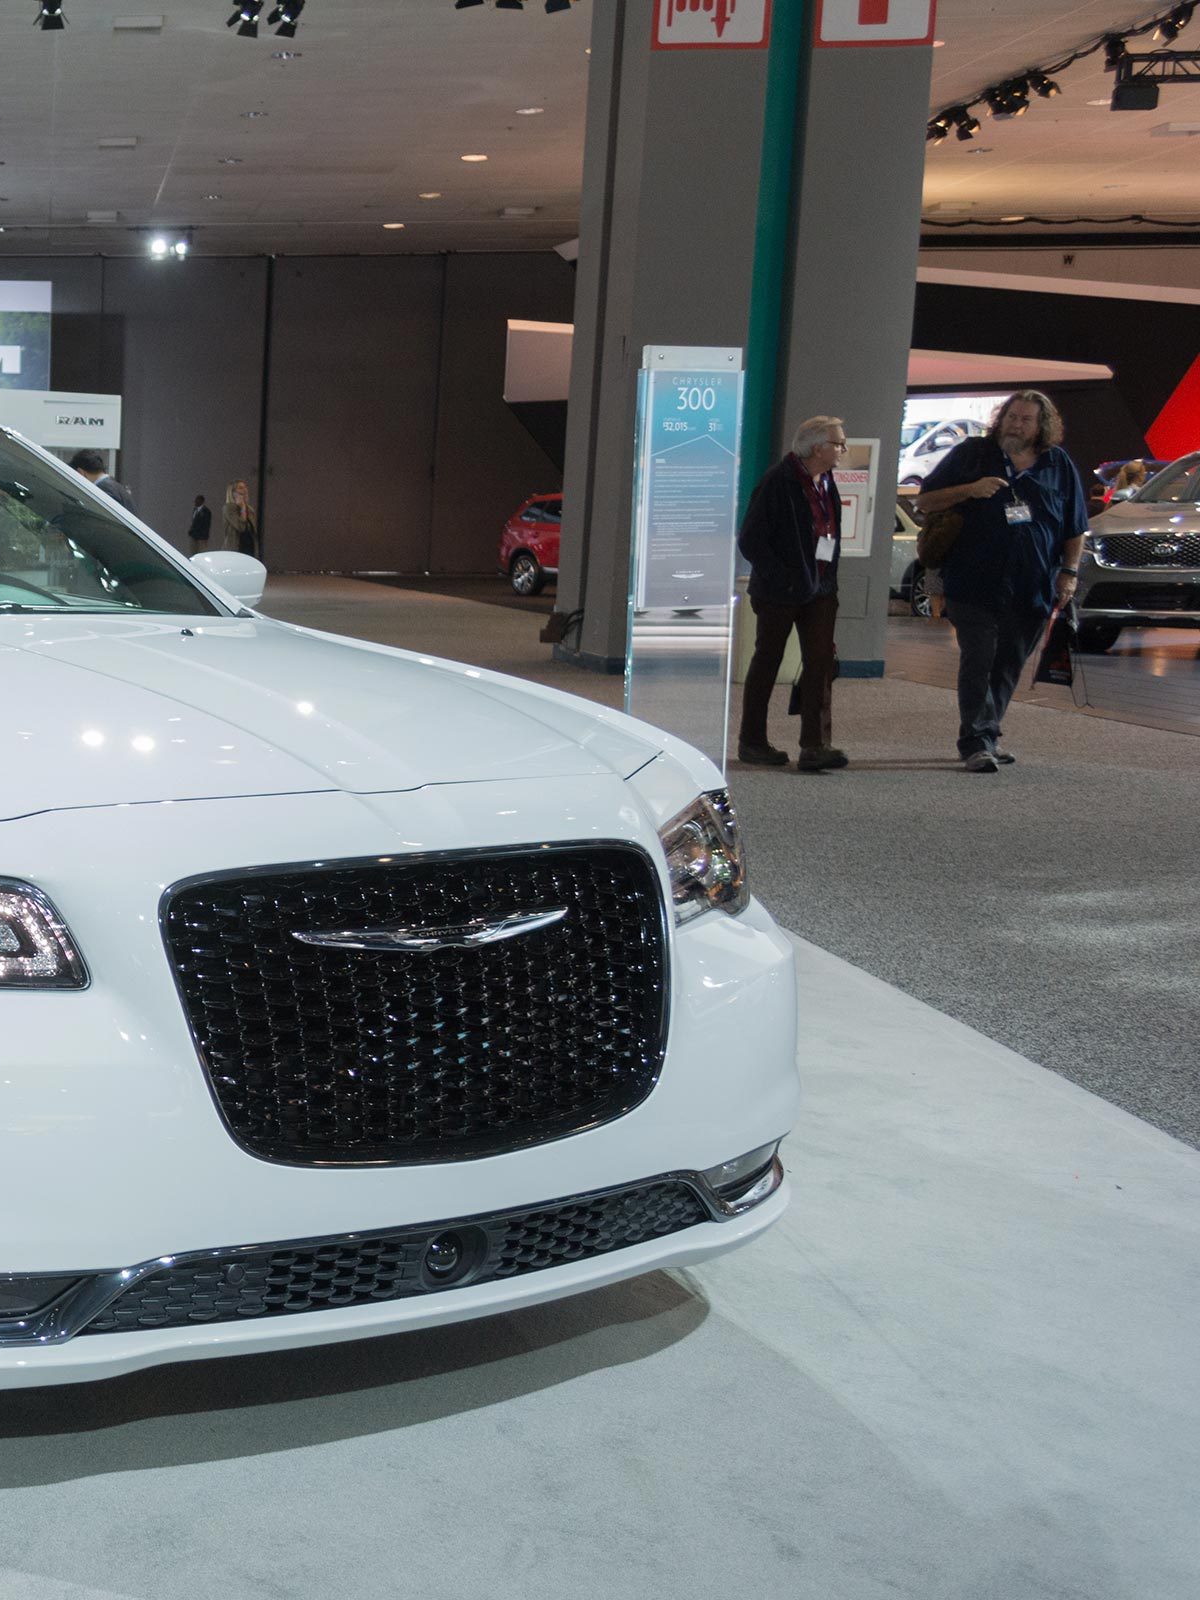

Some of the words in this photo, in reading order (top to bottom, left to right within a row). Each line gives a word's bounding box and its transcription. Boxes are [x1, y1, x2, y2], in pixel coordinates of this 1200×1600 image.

[672, 377, 722, 386] CHRYSLER
[676, 387, 715, 411] 300
[55, 415, 105, 426] RAM
